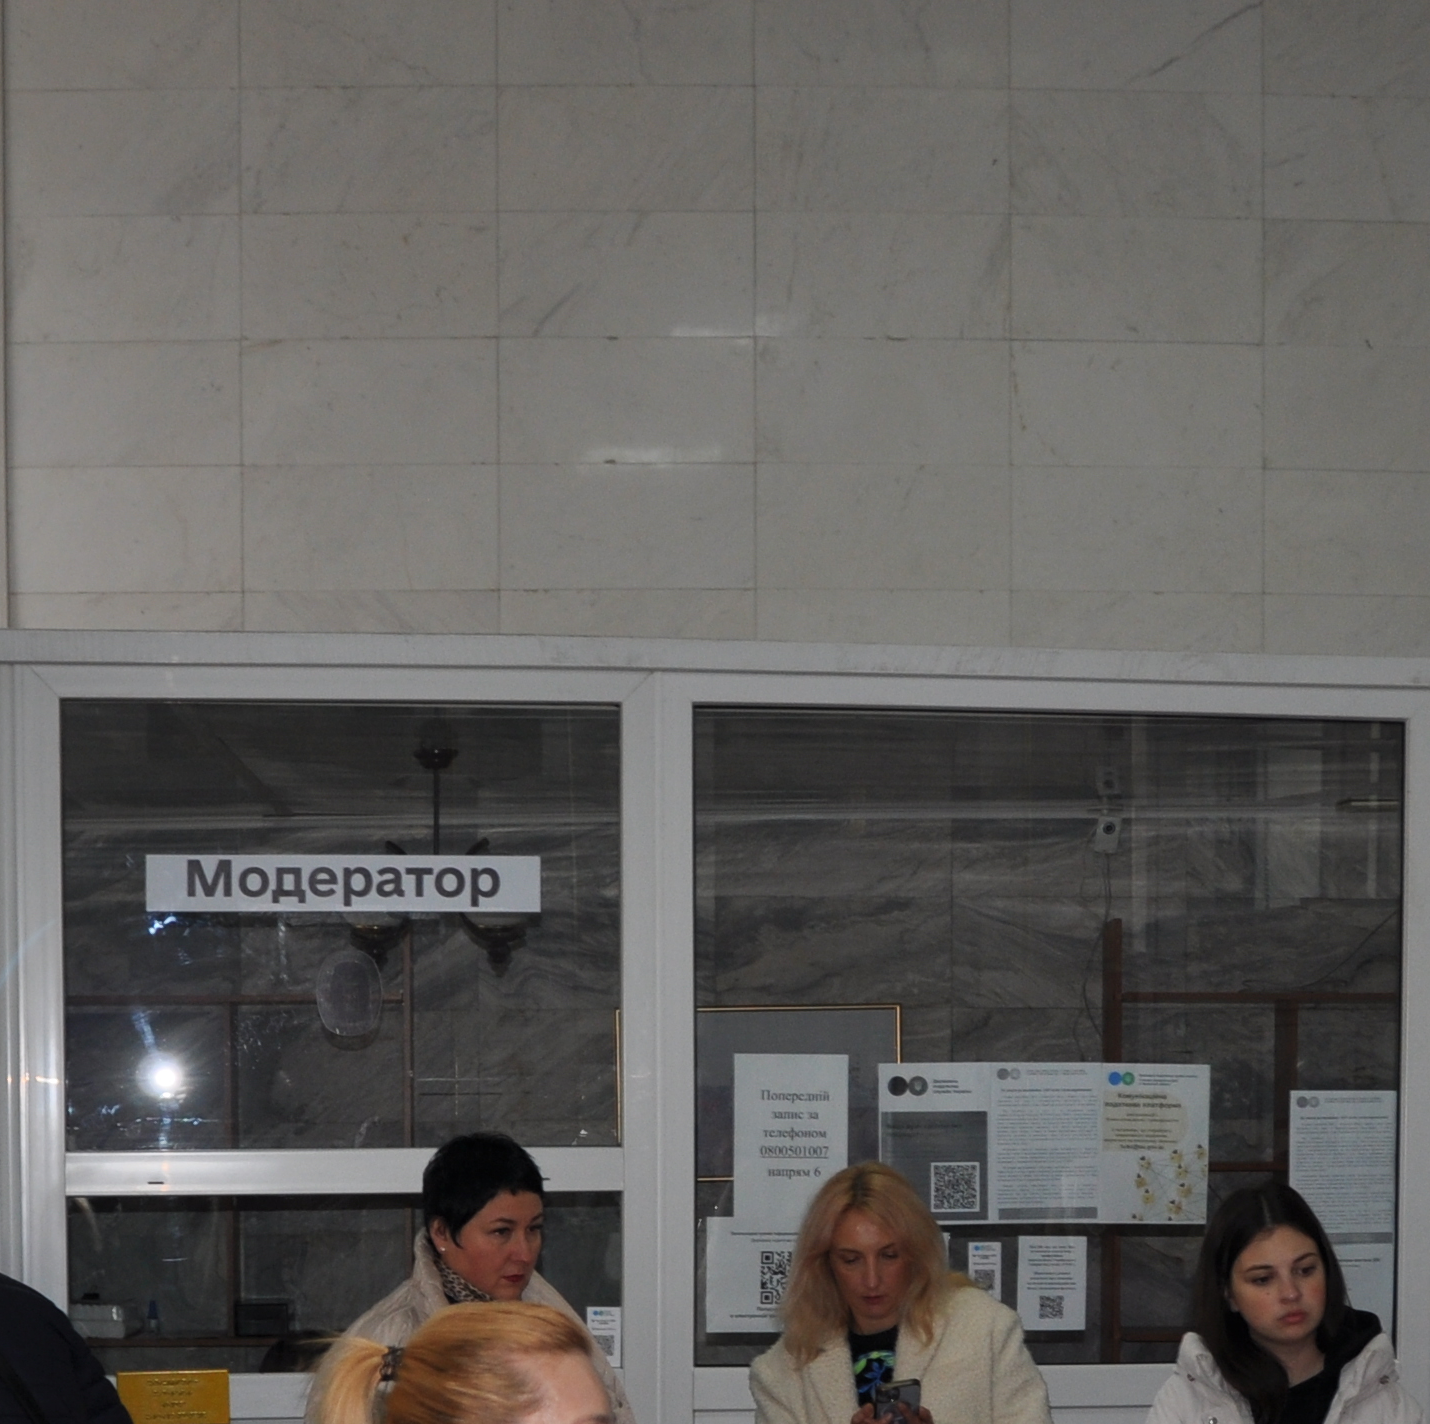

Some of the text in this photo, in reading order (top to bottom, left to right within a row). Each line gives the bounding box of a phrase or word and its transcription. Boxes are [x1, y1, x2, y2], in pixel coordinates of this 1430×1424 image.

[185, 858, 502, 908] Модератор
[760, 1089, 830, 1104] Попередній
[771, 1110, 820, 1121] запис за
[763, 1127, 827, 1141] телефоном
[759, 1146, 829, 1158] 0800501007
[767, 1166, 822, 1180] напрям 6
